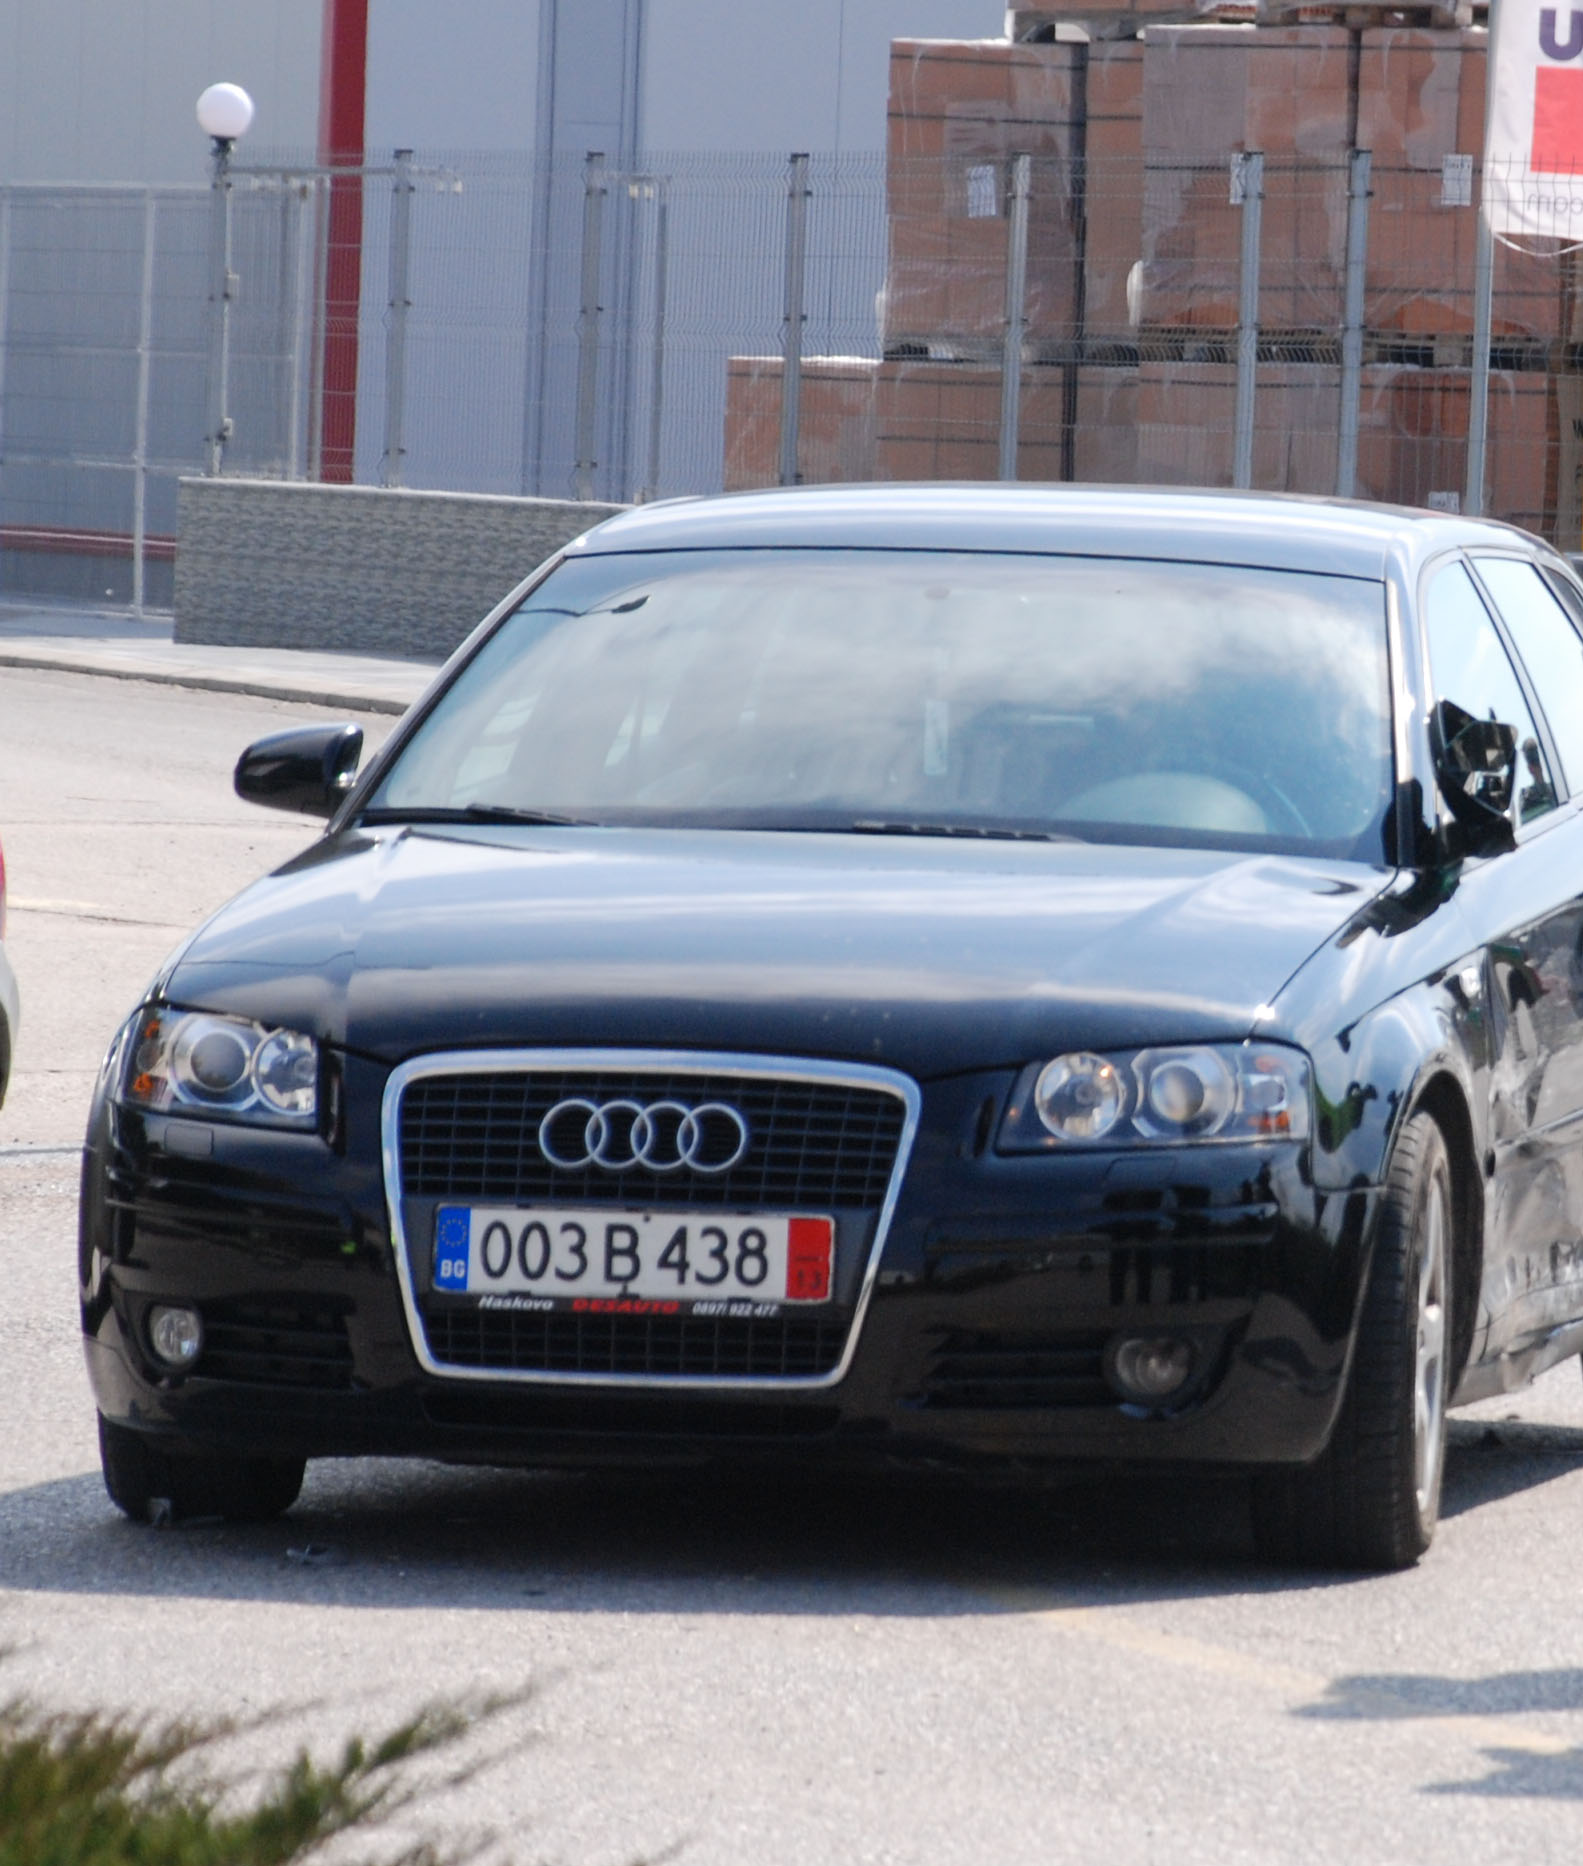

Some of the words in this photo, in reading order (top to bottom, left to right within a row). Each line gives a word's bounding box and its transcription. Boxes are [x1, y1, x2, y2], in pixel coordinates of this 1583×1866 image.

[480, 1220, 588, 1281] 003
[604, 1223, 641, 1284] B
[656, 1226, 769, 1286] 438
[440, 1260, 466, 1279] BG
[478, 1295, 554, 1311] Haskovo
